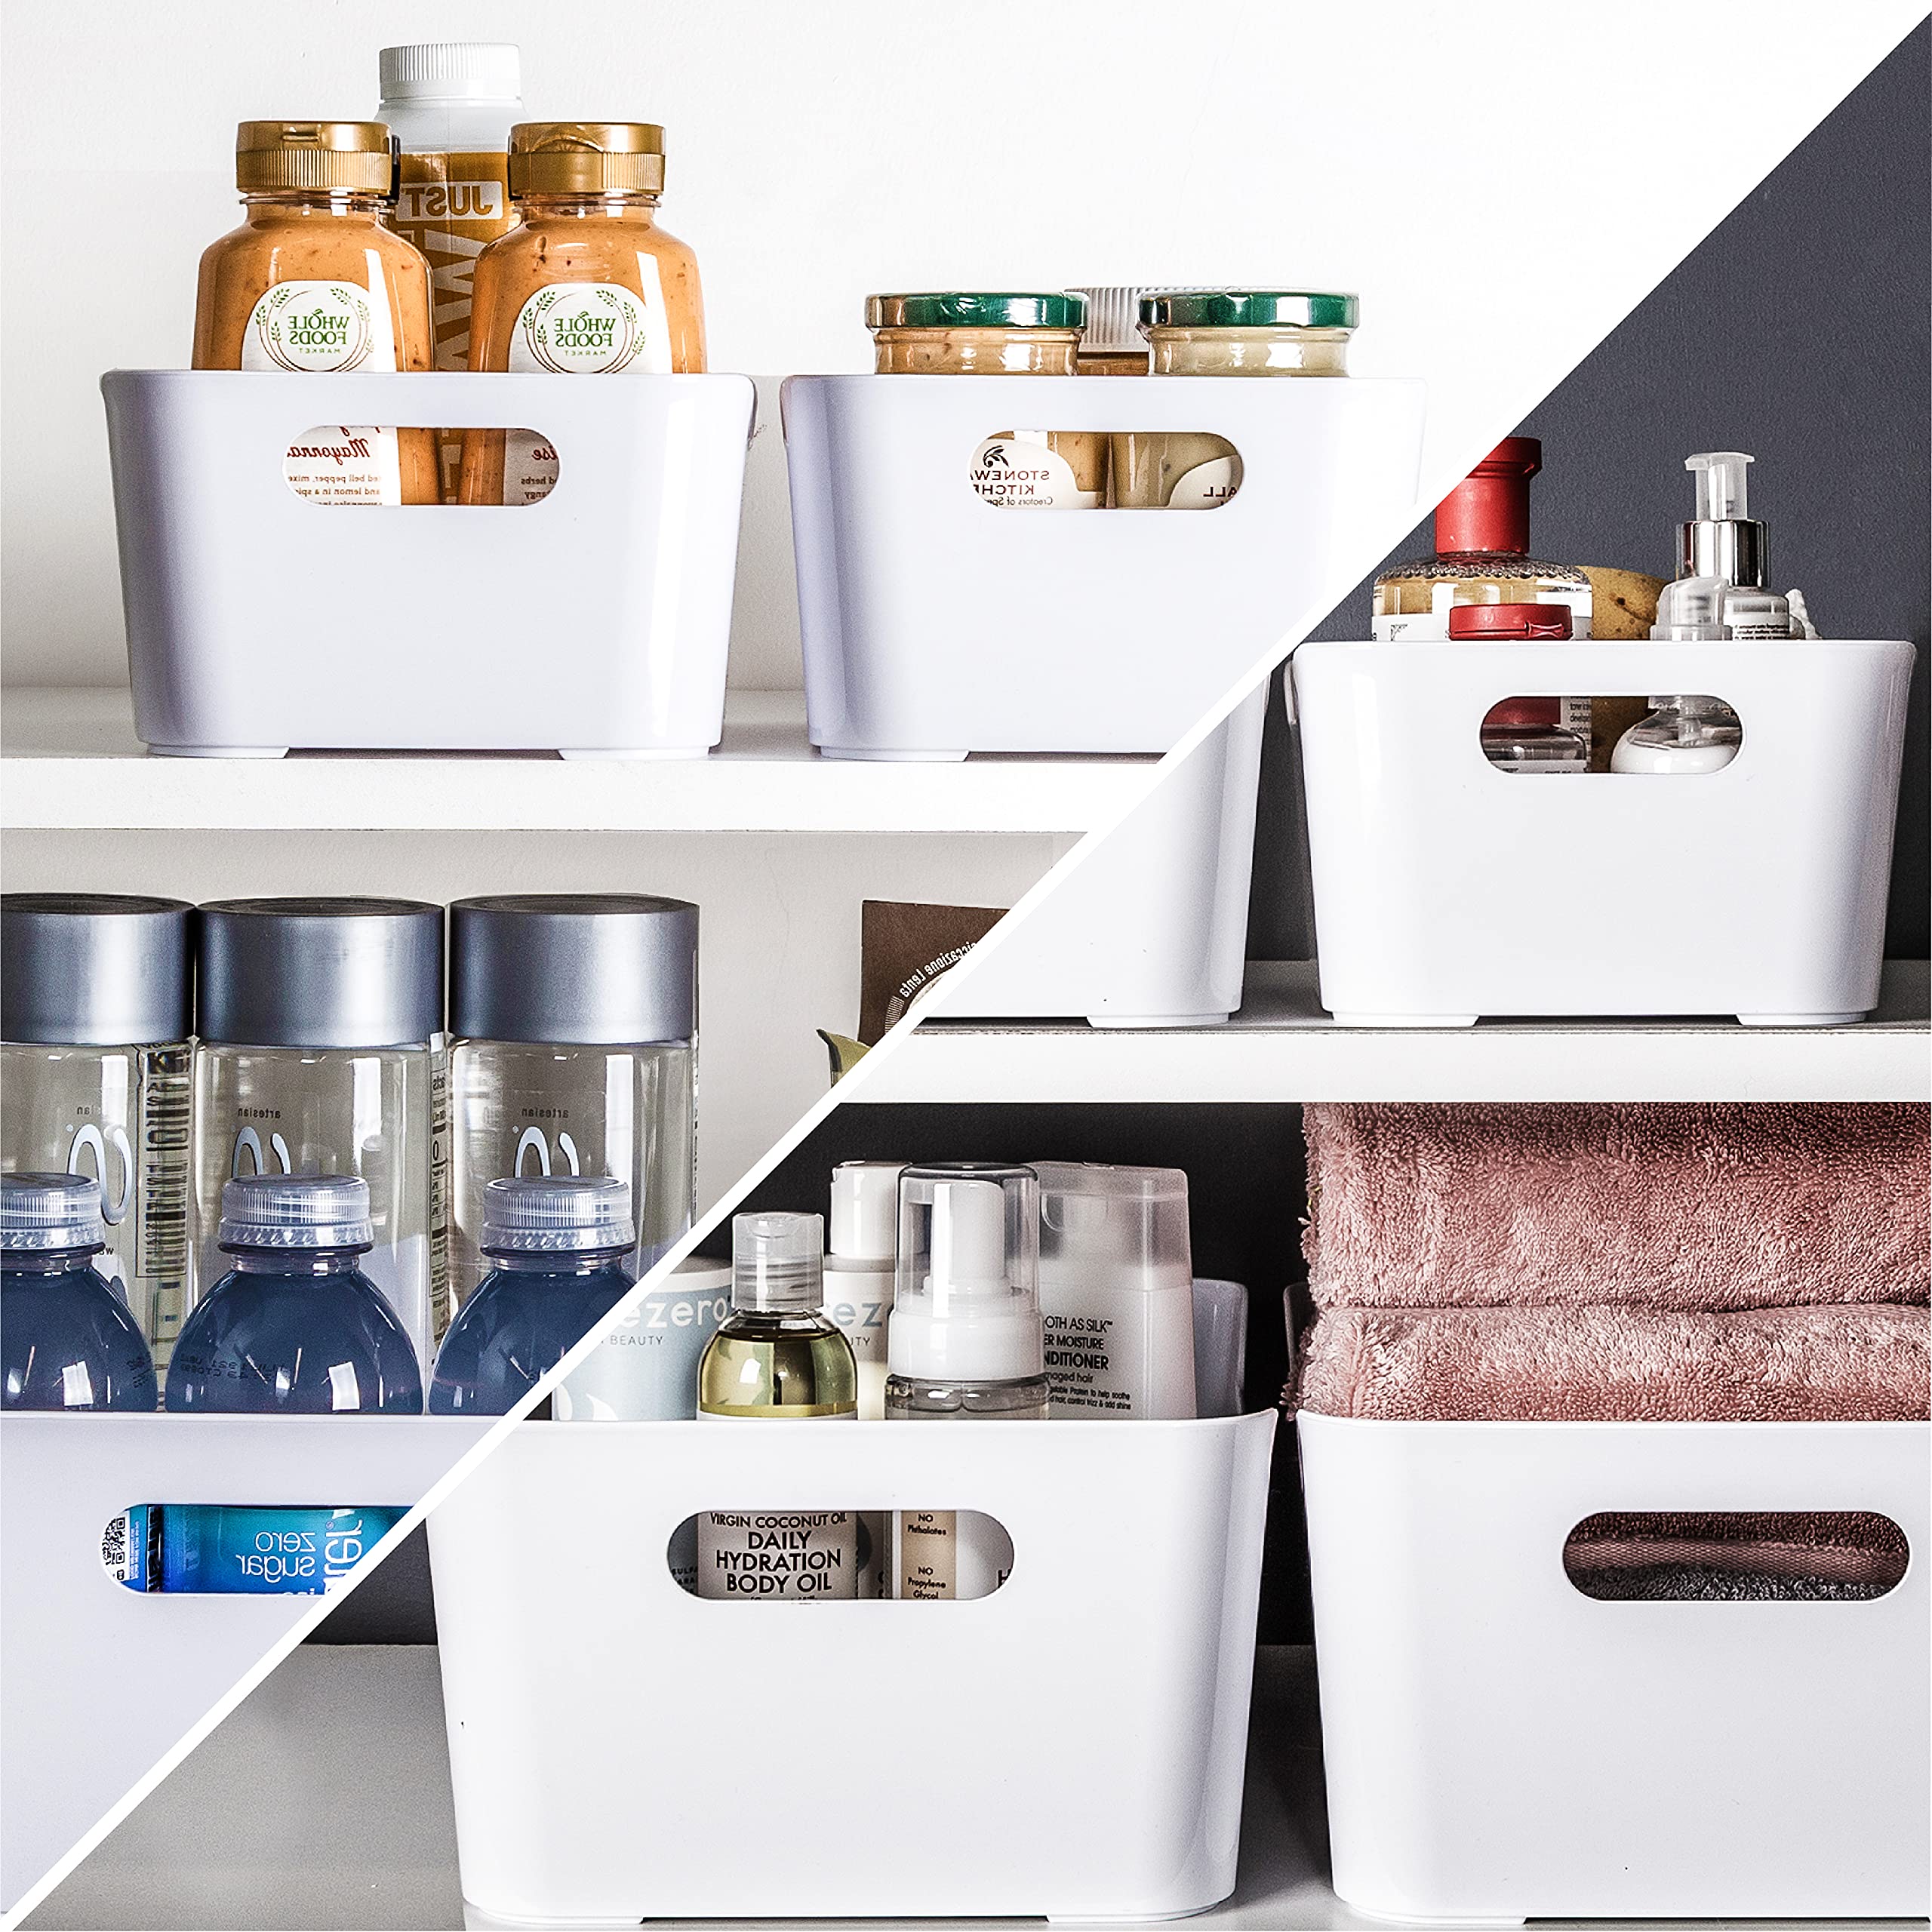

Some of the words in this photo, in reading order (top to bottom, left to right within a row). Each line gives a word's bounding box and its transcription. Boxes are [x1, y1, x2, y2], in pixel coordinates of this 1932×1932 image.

[1044, 1315, 1067, 1330] OTH
[1069, 1317, 1085, 1331] AS
[610, 1335, 663, 1346] BEAUTY
[1057, 1334, 1104, 1350] MOISTURE
[710, 1512, 752, 1528] VIRGIN
[755, 1514, 829, 1529] COCONUT
[918, 1514, 934, 1523] NO
[907, 1524, 947, 1536] Phthalates
[748, 1530, 812, 1549] DAILY
[716, 1548, 841, 1572] HYDRATION
[918, 1567, 934, 1576] NO
[727, 1572, 791, 1594] BODY
[796, 1571, 832, 1592] OIL
[907, 1577, 946, 1589] Propylene
[913, 1589, 939, 1600] Glycol
